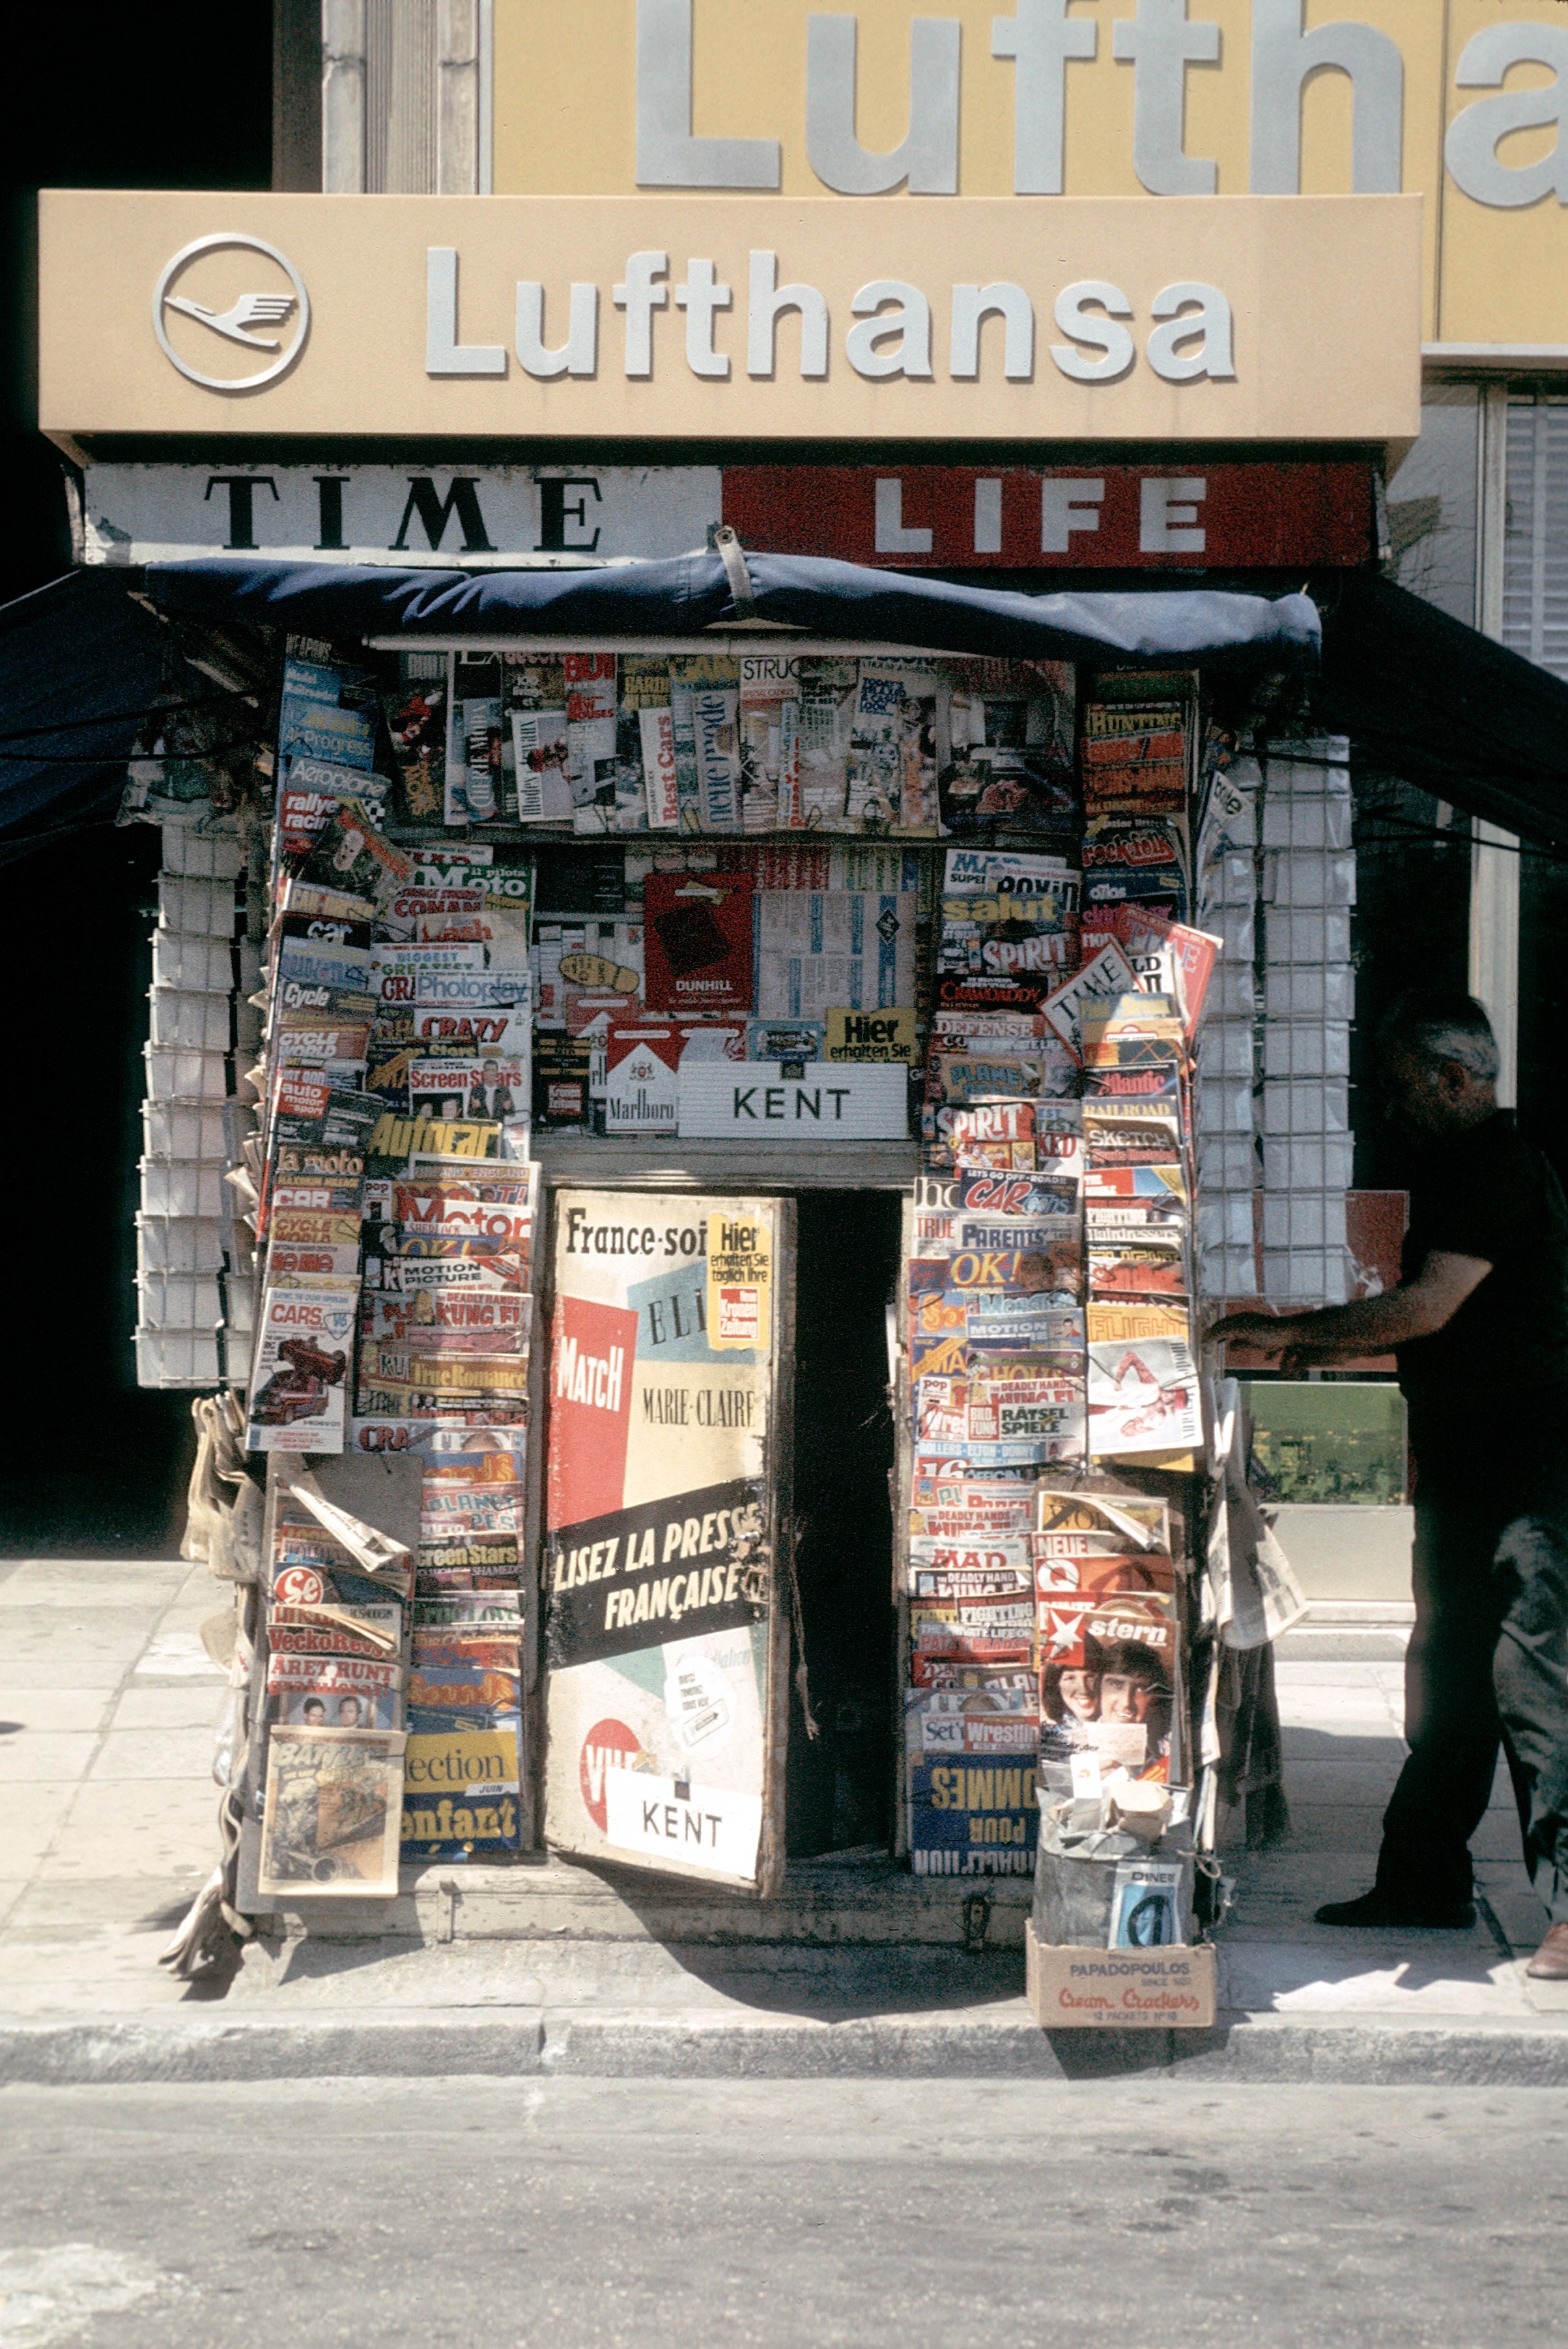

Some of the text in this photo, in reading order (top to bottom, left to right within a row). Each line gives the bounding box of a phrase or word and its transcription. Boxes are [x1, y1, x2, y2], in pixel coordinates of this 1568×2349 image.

[425, 248, 1237, 382] Lufthansa
[203, 476, 603, 553] TIME
[874, 477, 1207, 554] LIFE
[657, 715, 678, 822] Best Cars
[285, 793, 340, 815] rallye
[394, 899, 481, 918] CONAN
[943, 893, 1059, 922] salut
[982, 932, 1071, 975] SPIRIT
[284, 982, 331, 1009] Cycle
[418, 976, 528, 1002] Photoplay
[675, 980, 734, 992] DUNHILL
[279, 1031, 339, 1046] CYCLE
[422, 1016, 509, 1043] CRAZY
[844, 1016, 898, 1043] Hier
[830, 1043, 911, 1060] erhalten Sie
[281, 1082, 322, 1098] auto
[411, 1070, 468, 1088] Screen
[610, 1088, 674, 1119] Marlboro
[734, 1088, 850, 1119] KENT
[1083, 1103, 1171, 1116] RAILROAD
[936, 1102, 1023, 1142] SPIRIT
[278, 1146, 364, 1176] la moto
[274, 1189, 331, 1207] CAR
[276, 1218, 332, 1233] CYCLE
[399, 1196, 532, 1237] Motor
[720, 1222, 757, 1252] Hier
[916, 1217, 954, 1239] TRUE
[405, 1263, 481, 1277] MOTION
[710, 1253, 769, 1267] erhalten Sie
[950, 1250, 1022, 1286] OK!
[405, 1273, 483, 1284] PICTURE
[747, 1269, 767, 1282] Ihre
[270, 1304, 323, 1325] CARS
[436, 1303, 493, 1325] KUNG
[720, 1299, 757, 1318] Kronen
[720, 1318, 757, 1339] Zeitung
[1089, 1315, 1180, 1342] FLIGHT
[557, 1335, 624, 1413] MATCH
[924, 1379, 947, 1391] pop
[1001, 1406, 1069, 1421] RÄTSEL
[1001, 1421, 1061, 1435] SPIELE
[920, 1459, 967, 1478] 16
[938, 1510, 974, 1521] DEADLY
[469, 1545, 519, 1565] Stars
[1037, 1536, 1089, 1557] NEUE
[553, 1537, 620, 1592] LISEZ
[624, 1528, 655, 1572] LA
[935, 1548, 1007, 1568] MAD
[948, 1572, 985, 1583] DEADLY
[604, 1562, 741, 1630] FRANÇAISE
[1089, 1617, 1167, 1643] stern
[336, 1661, 395, 1685] RUNT
[479, 1783, 504, 1794] JUIN
[642, 1800, 722, 1847] KENT
[969, 1817, 1026, 1843] POUR
[1070, 1963, 1190, 1977] PAPADOPOULOS
[1141, 1978, 1168, 1987] SINCE
[1059, 1987, 1200, 2011] Cream Crackers
